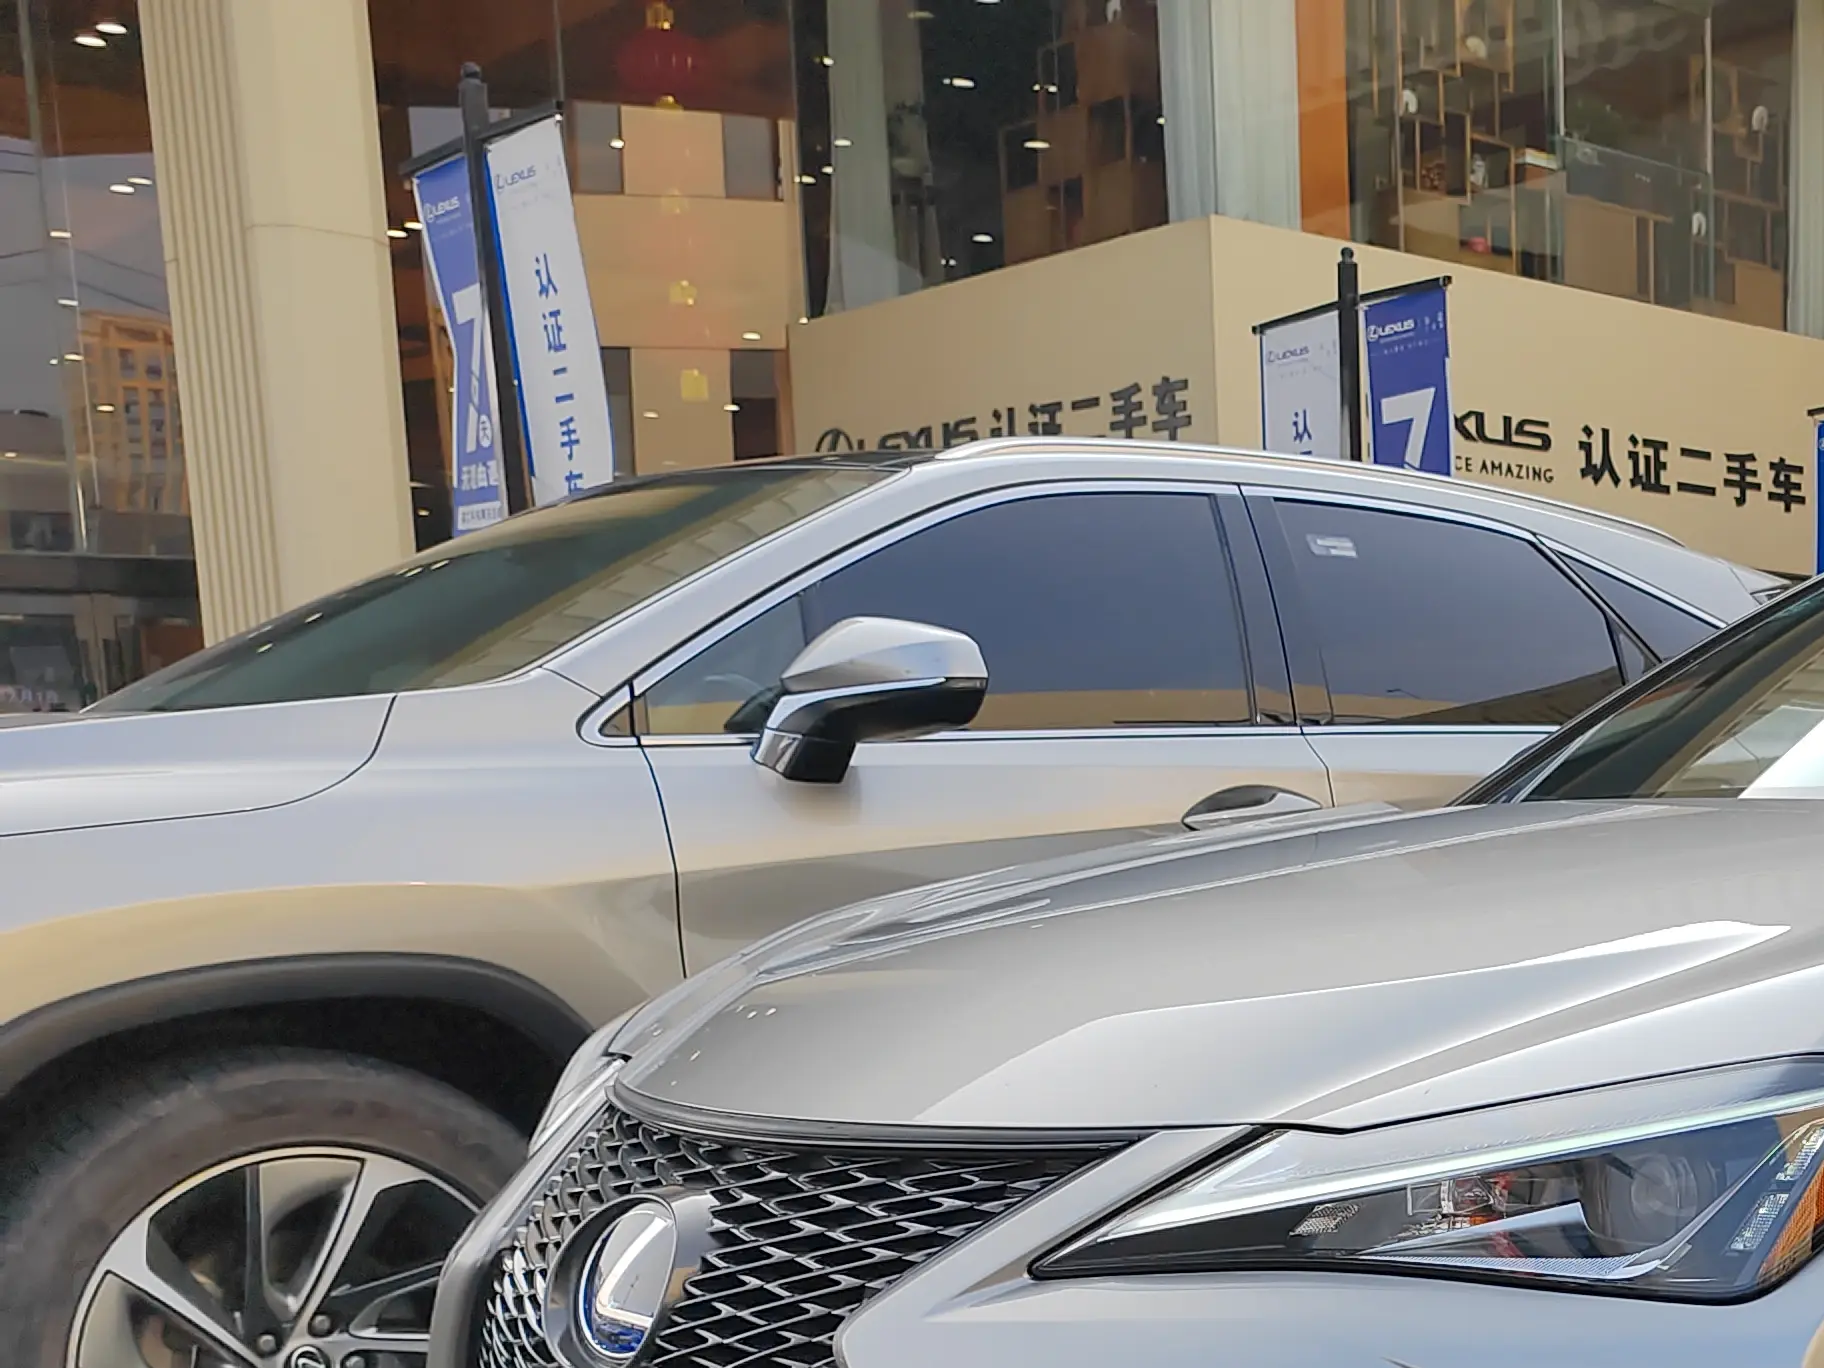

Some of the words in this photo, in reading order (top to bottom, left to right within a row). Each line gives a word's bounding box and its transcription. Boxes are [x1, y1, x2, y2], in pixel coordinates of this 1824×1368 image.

[505, 165, 537, 187] LEXUS
[1378, 319, 1415, 338] LEXUS
[1479, 460, 1555, 484] AMAZING
[1578, 424, 1806, 513] 认证二手车
